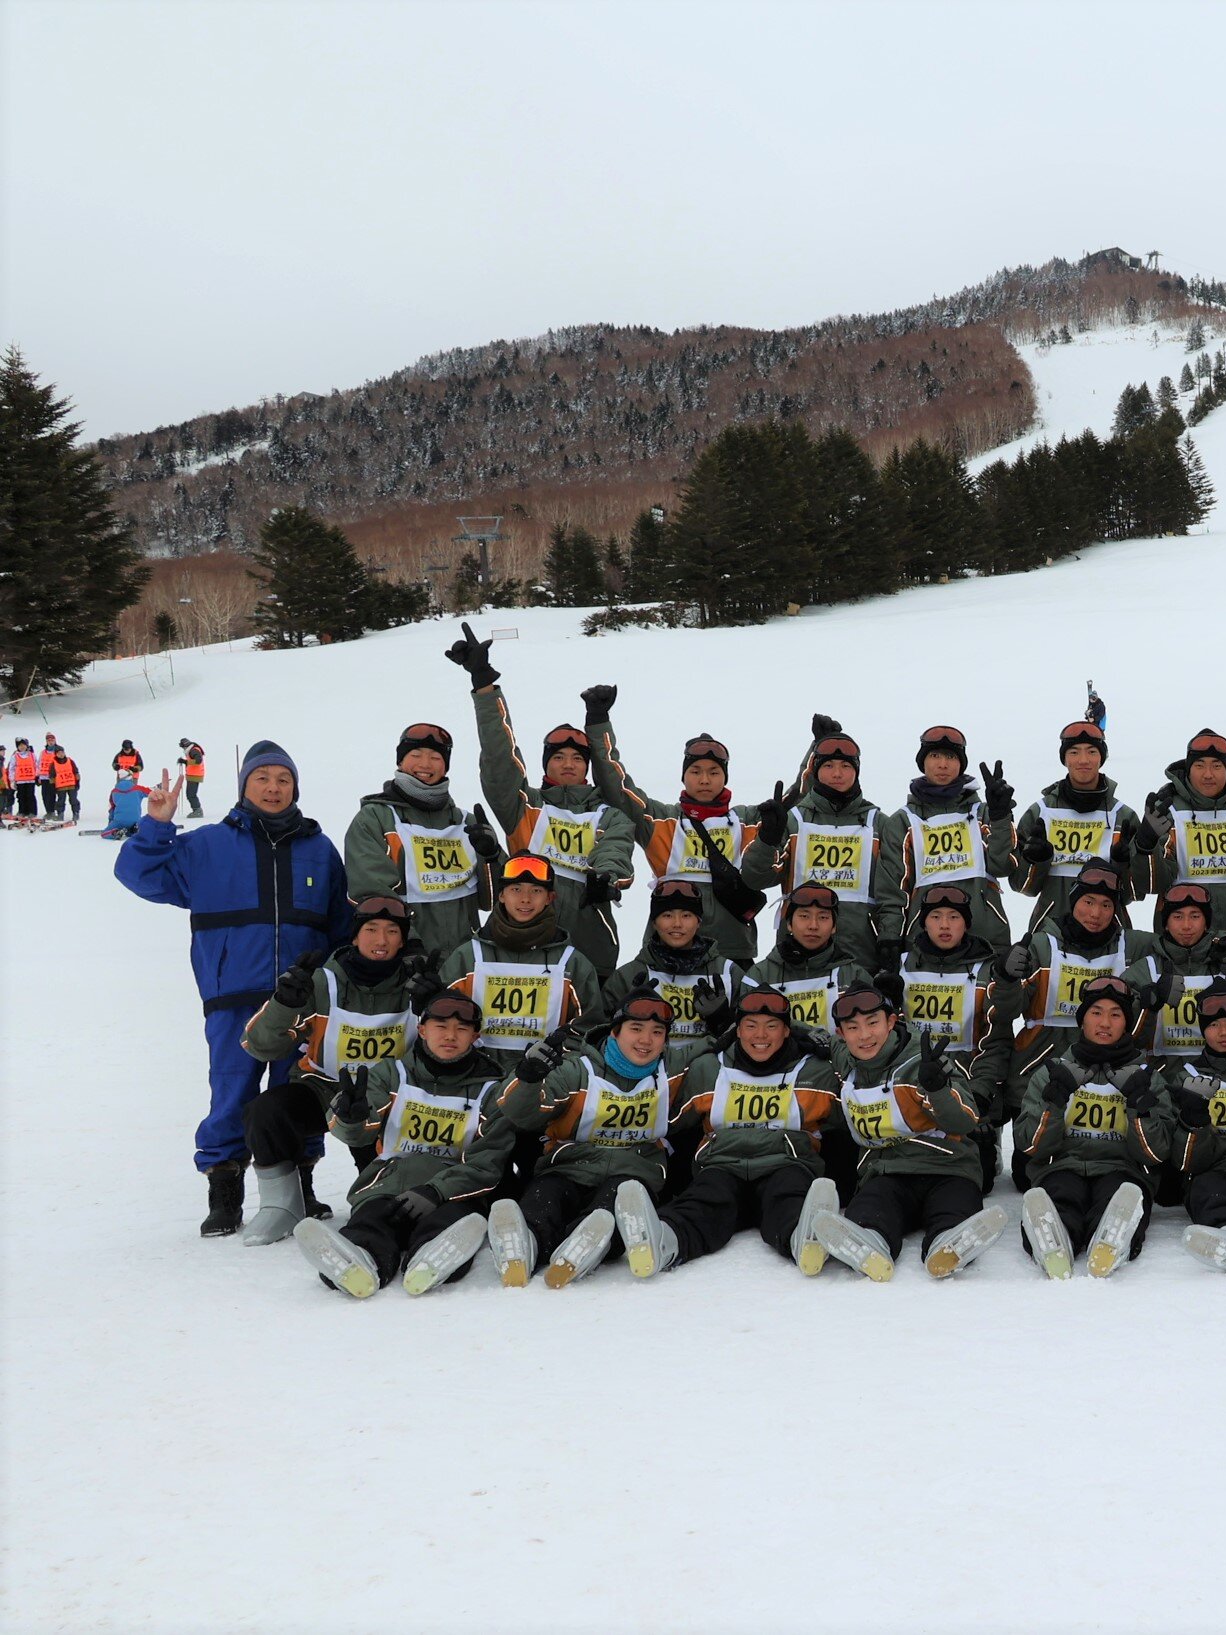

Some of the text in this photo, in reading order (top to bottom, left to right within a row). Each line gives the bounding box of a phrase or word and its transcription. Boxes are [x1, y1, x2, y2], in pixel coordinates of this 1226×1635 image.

[19, 767, 33, 775] 152
[928, 830, 963, 856] 203
[1054, 829, 1093, 853] 301
[423, 846, 464, 870] 504
[812, 844, 854, 868] 202
[1190, 857, 1204, 868] 柳
[488, 977, 548, 987] 初芝立命館高等学校
[909, 983, 962, 993] 初芝立命館高等学校
[491, 988, 538, 1014] 401
[792, 1002, 820, 1024] 04
[912, 995, 954, 1020] 204
[342, 1026, 402, 1036] 初芝立命館高等学校
[1167, 1027, 1192, 1038] 竹内
[346, 1038, 396, 1059] 502
[406, 1101, 466, 1122] 初芝立命館高等学校
[601, 1102, 650, 1128] 205
[734, 1095, 780, 1120] 106
[1072, 1102, 1117, 1129] 201
[408, 1115, 454, 1146] 304
